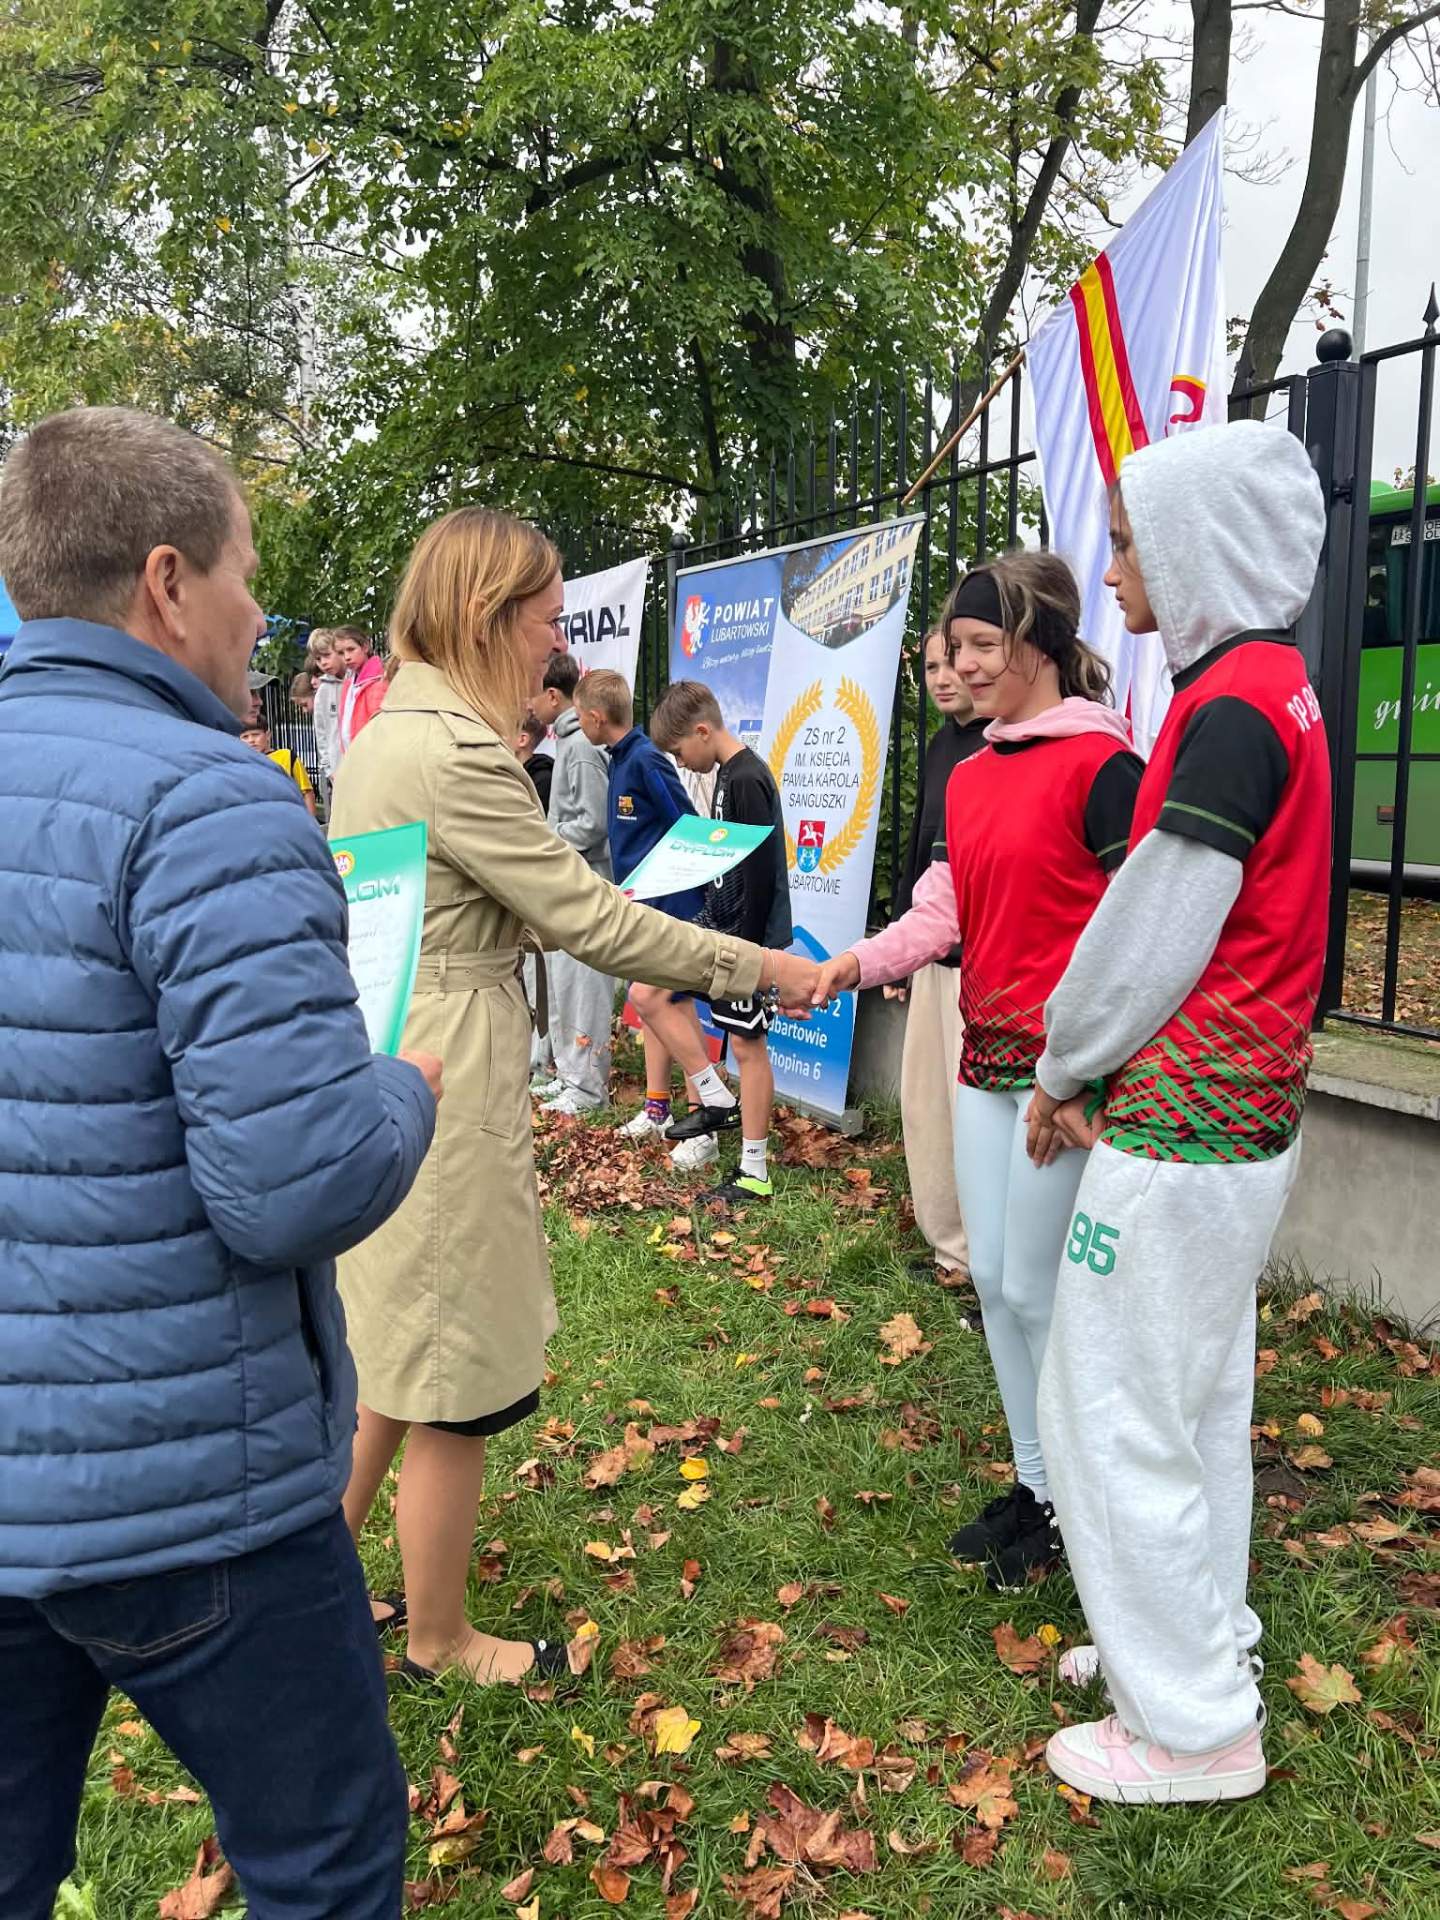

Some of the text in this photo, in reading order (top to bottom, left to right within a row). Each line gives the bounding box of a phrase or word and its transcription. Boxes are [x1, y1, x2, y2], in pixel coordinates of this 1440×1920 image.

[713, 597, 774, 625] POWIAT
[710, 621, 770, 643] LUBARTOWSKI
[803, 726, 846, 746] ZS nr 2
[809, 751, 850, 770] KSIĘCIA
[782, 772, 860, 788] PAWŁA KAROLA
[788, 793, 847, 809] SANGUSZKI
[788, 872, 841, 895] UBARTOWIE
[768, 1014, 828, 1048] bartowie
[812, 1061, 822, 1081] 6
[1067, 1211, 1120, 1276] 95
